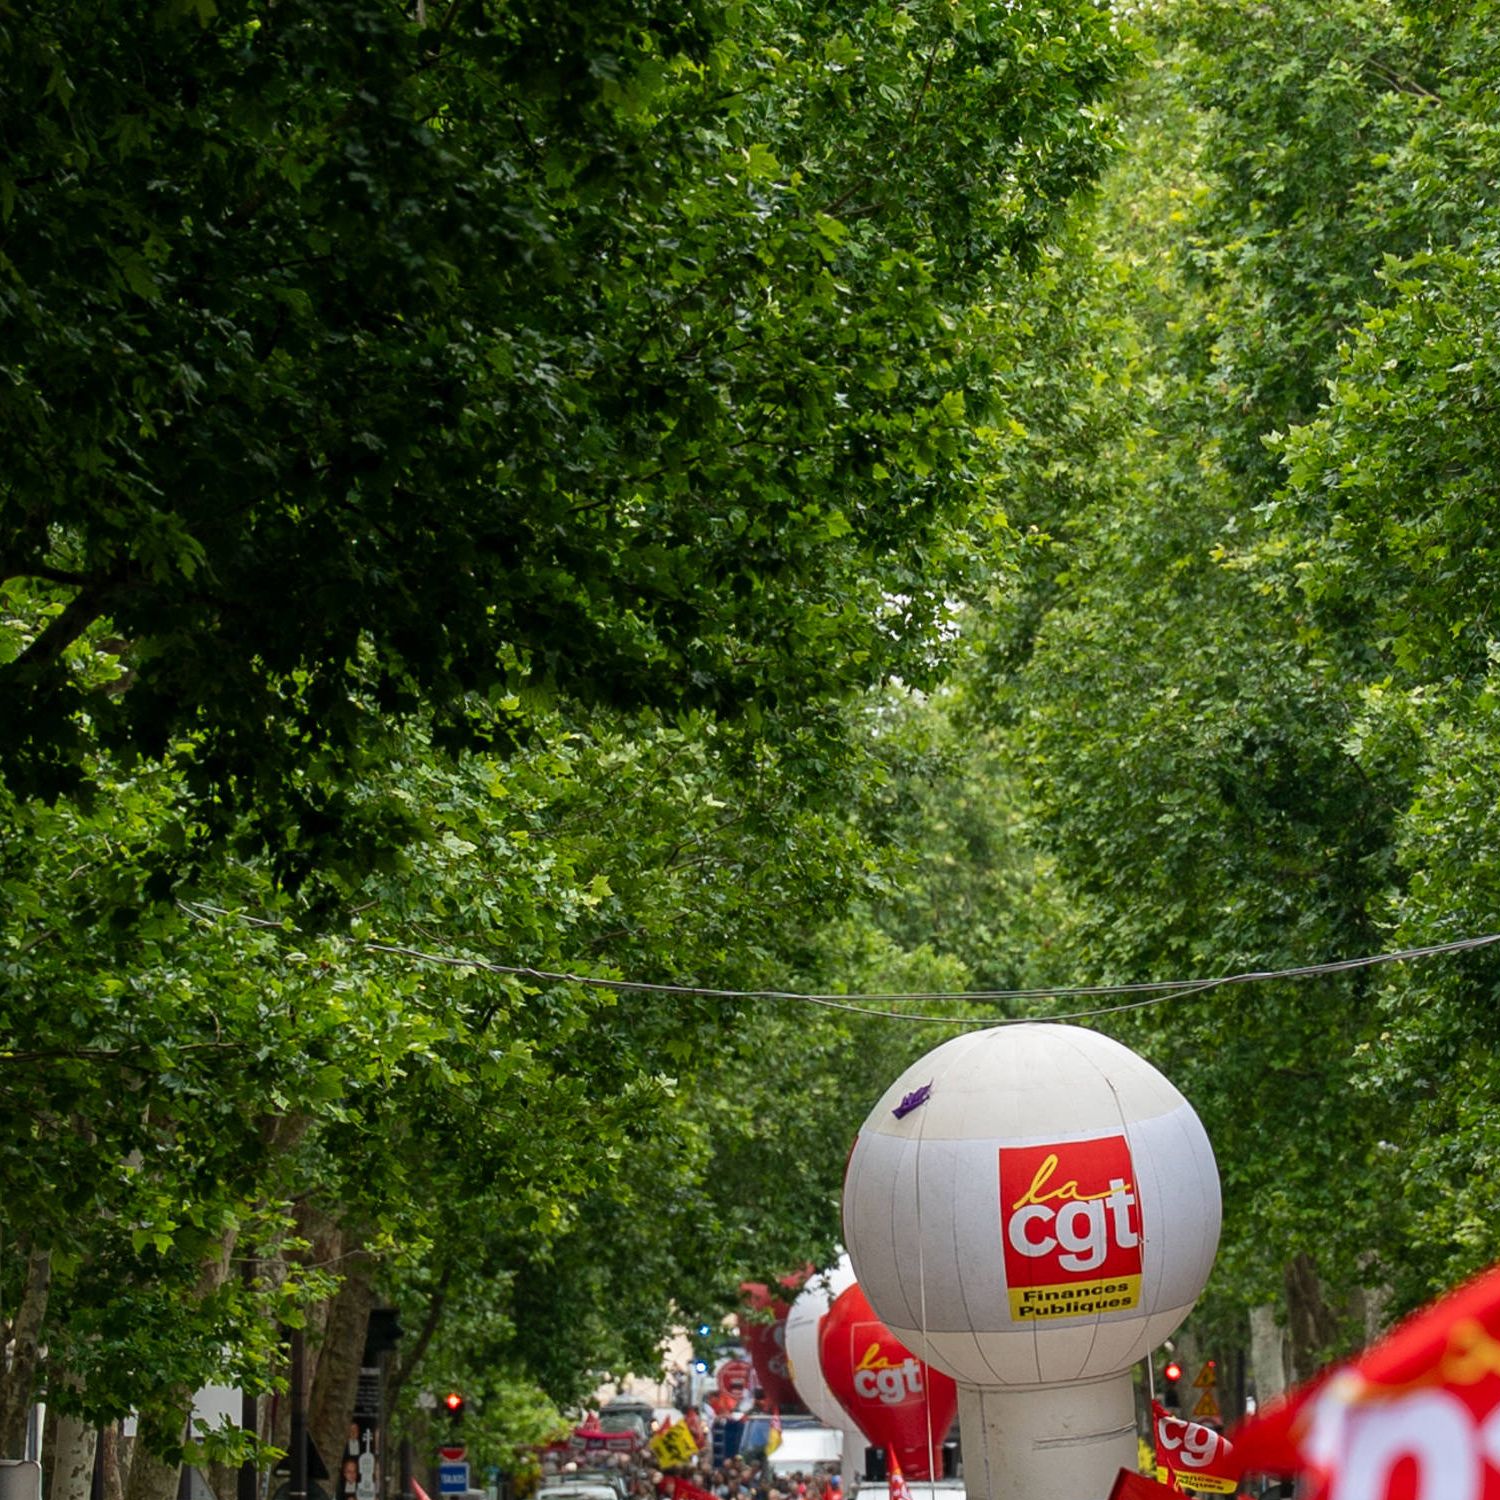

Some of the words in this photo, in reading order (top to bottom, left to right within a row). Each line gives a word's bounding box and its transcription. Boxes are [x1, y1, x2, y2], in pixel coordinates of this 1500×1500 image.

[1013, 1154, 1116, 1209] la
[1008, 1179, 1138, 1272] cgt
[1019, 1295, 1132, 1317] Publiques
[1023, 1282, 1129, 1302] Finances
[854, 1358, 922, 1404] cgt
